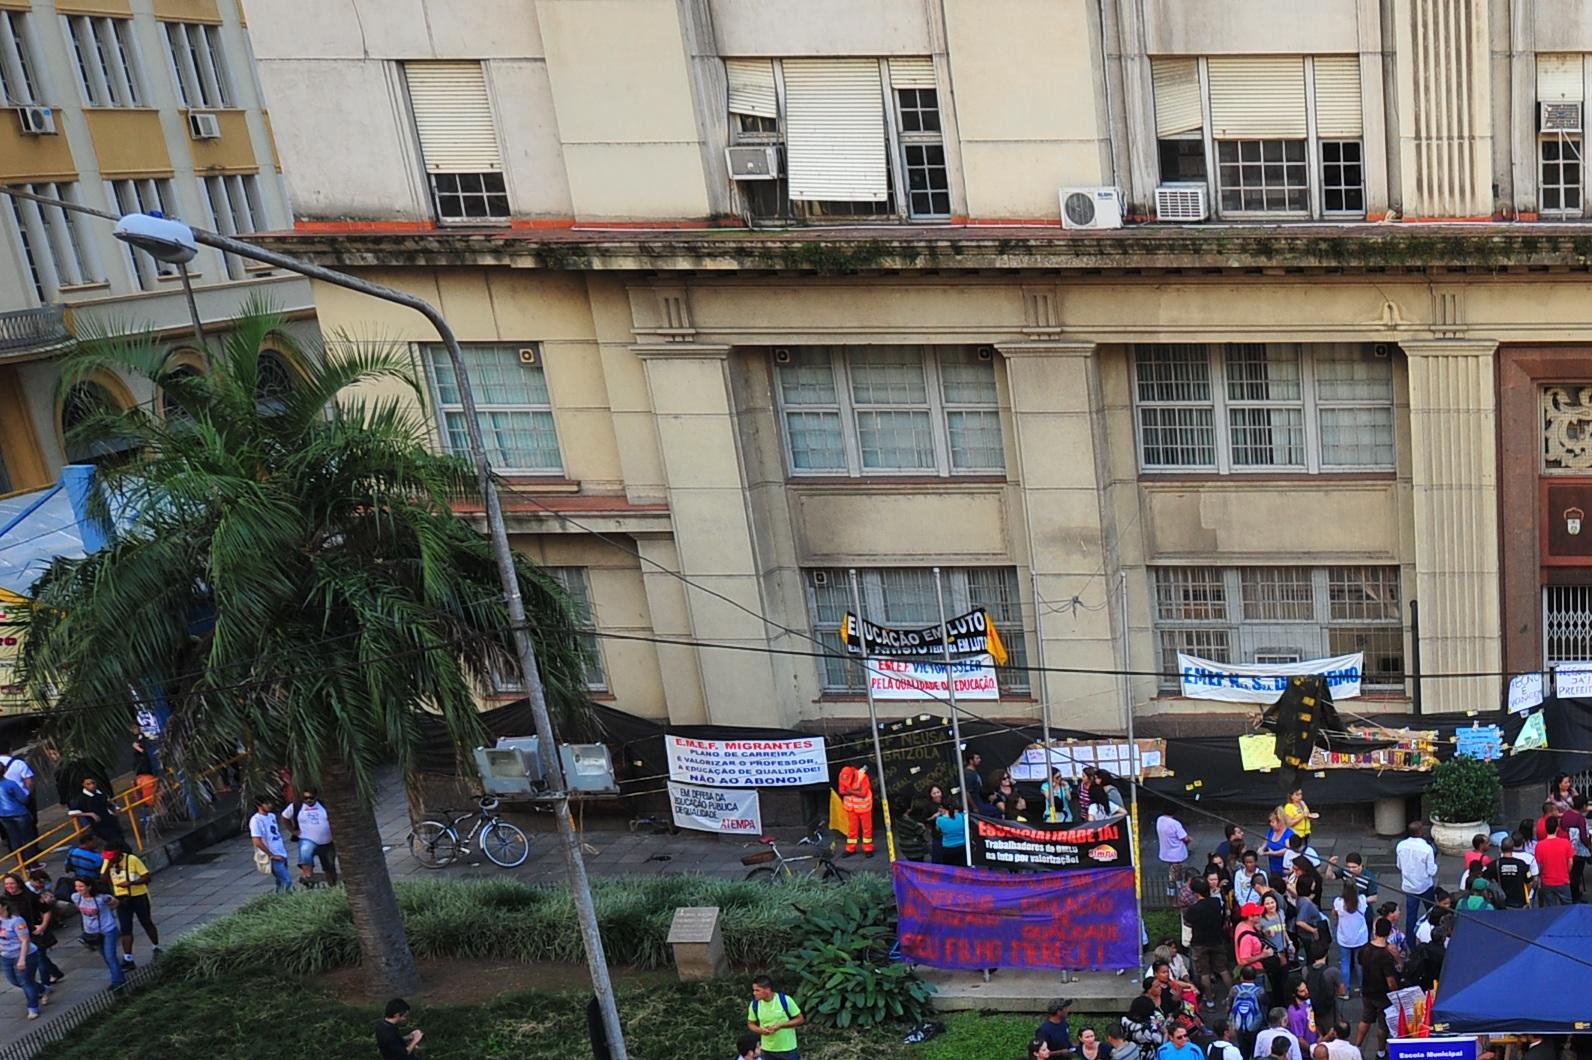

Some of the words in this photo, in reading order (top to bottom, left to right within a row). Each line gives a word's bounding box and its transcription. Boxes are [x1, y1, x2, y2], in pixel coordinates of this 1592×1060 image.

[847, 614, 920, 647] EUCAÇÃO
[948, 611, 985, 636] LUTO
[872, 677, 893, 690] PELA
[901, 731, 946, 746] NEUSA
[725, 740, 813, 751] MIGRANTES
[690, 750, 720, 758] PLANO
[724, 750, 737, 758] DE
[741, 750, 796, 758] CARREIRA
[684, 757, 736, 766] VALORIZAR
[686, 765, 737, 775] EDUCAÇÃO
[690, 774, 716, 784] NÃO
[719, 776, 740, 784] AO
[744, 776, 802, 785] ABONO!
[985, 839, 1044, 852] Trabalhadores
[1015, 853, 1028, 863] por
[1427, 1050, 1463, 1058] Municipal
